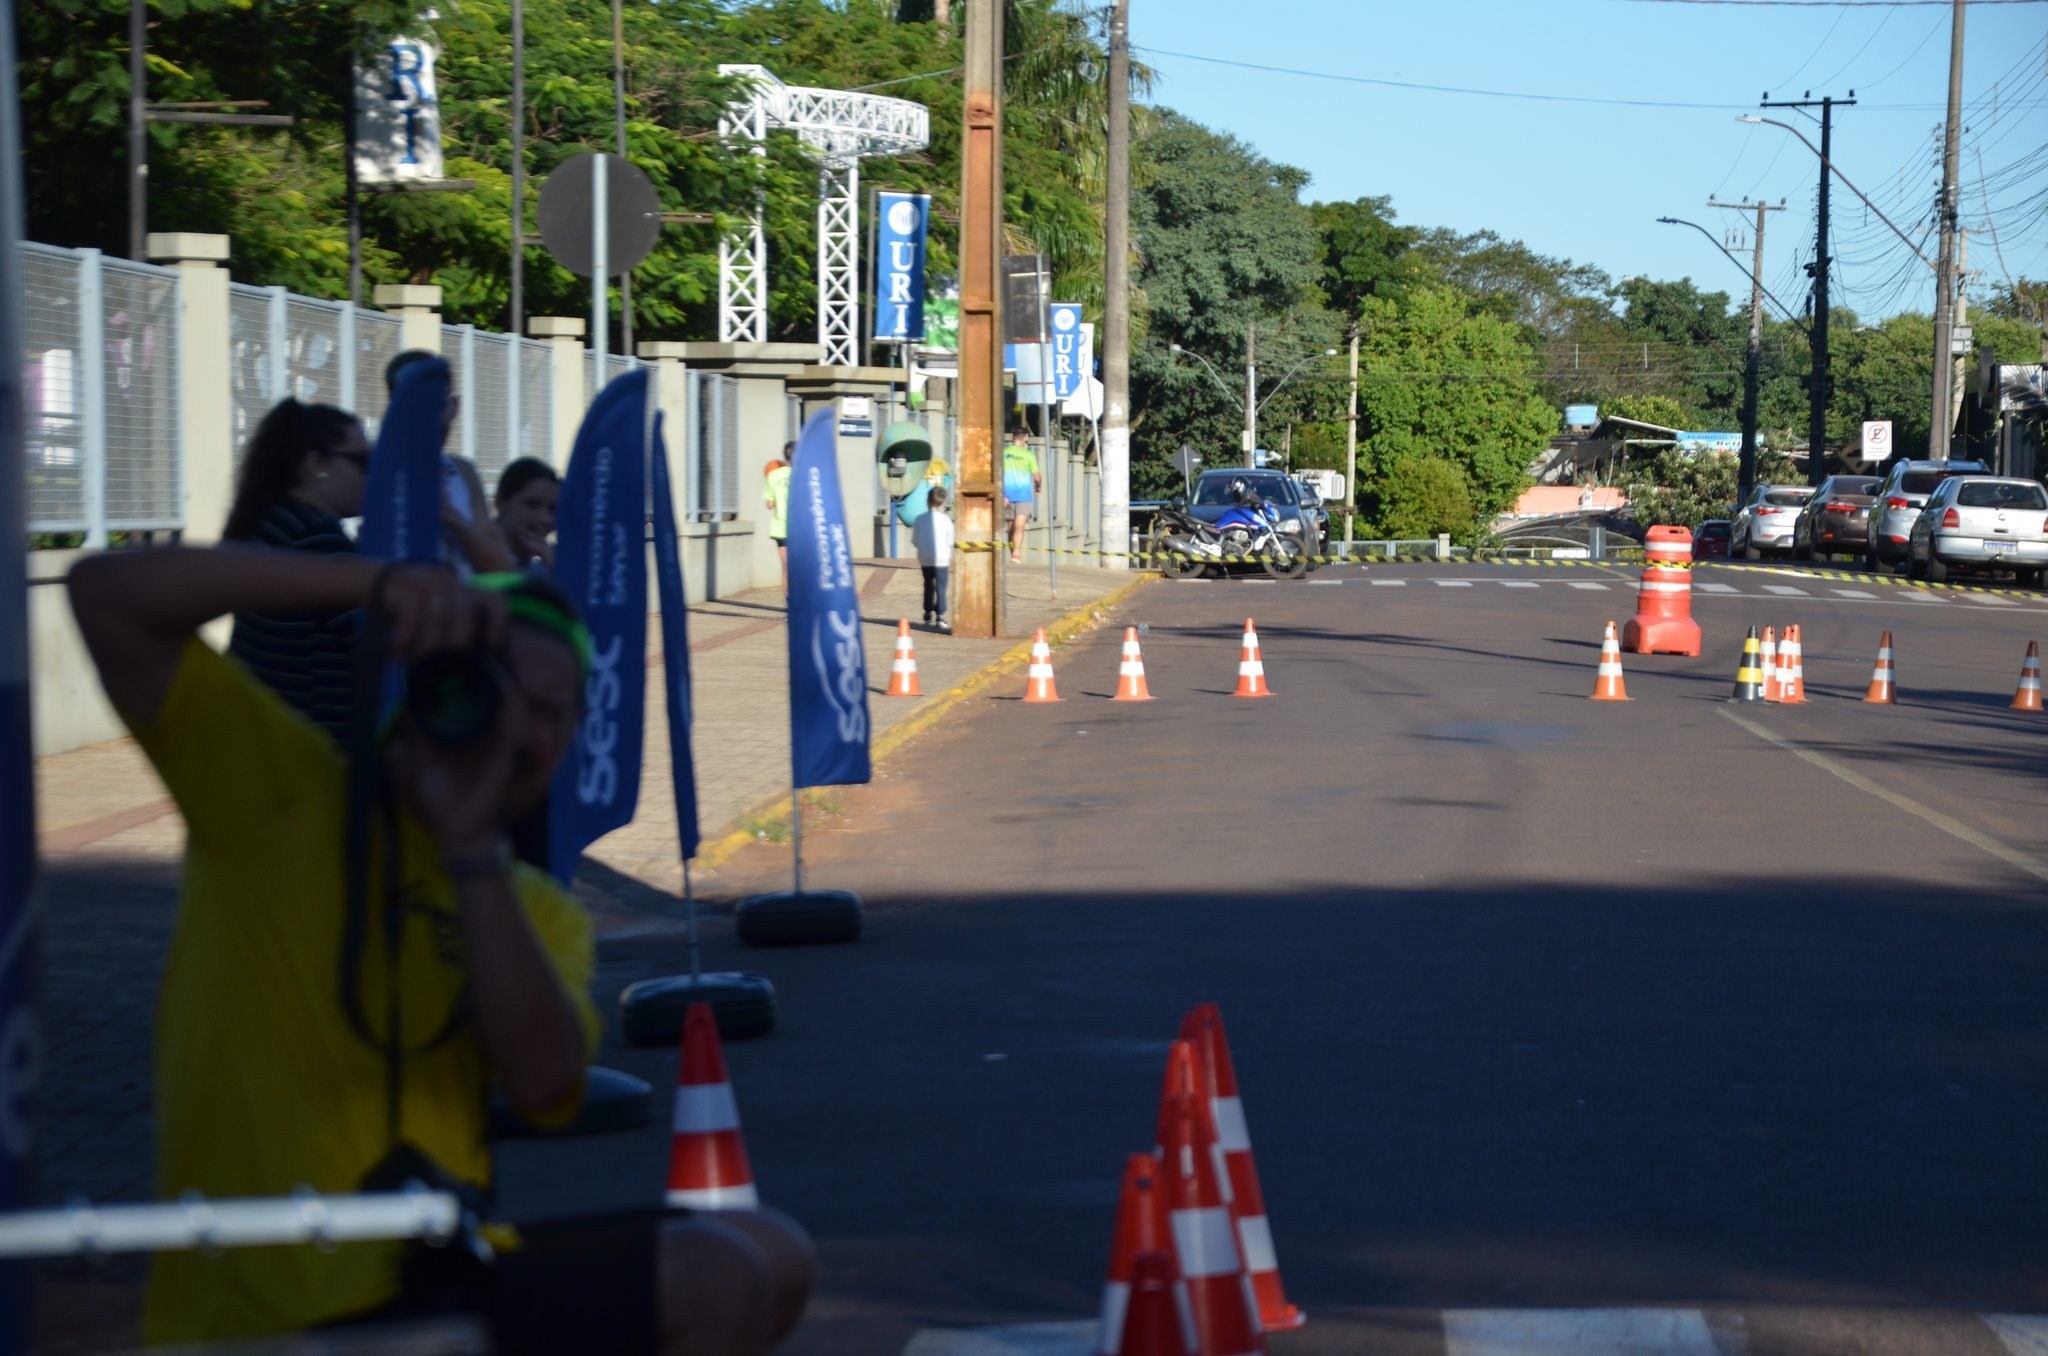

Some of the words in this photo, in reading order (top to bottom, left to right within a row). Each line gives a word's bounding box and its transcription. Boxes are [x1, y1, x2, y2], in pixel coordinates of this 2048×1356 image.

[386, 44, 433, 163] RI
[889, 241, 916, 333] URI
[1056, 334, 1073, 394] URI
